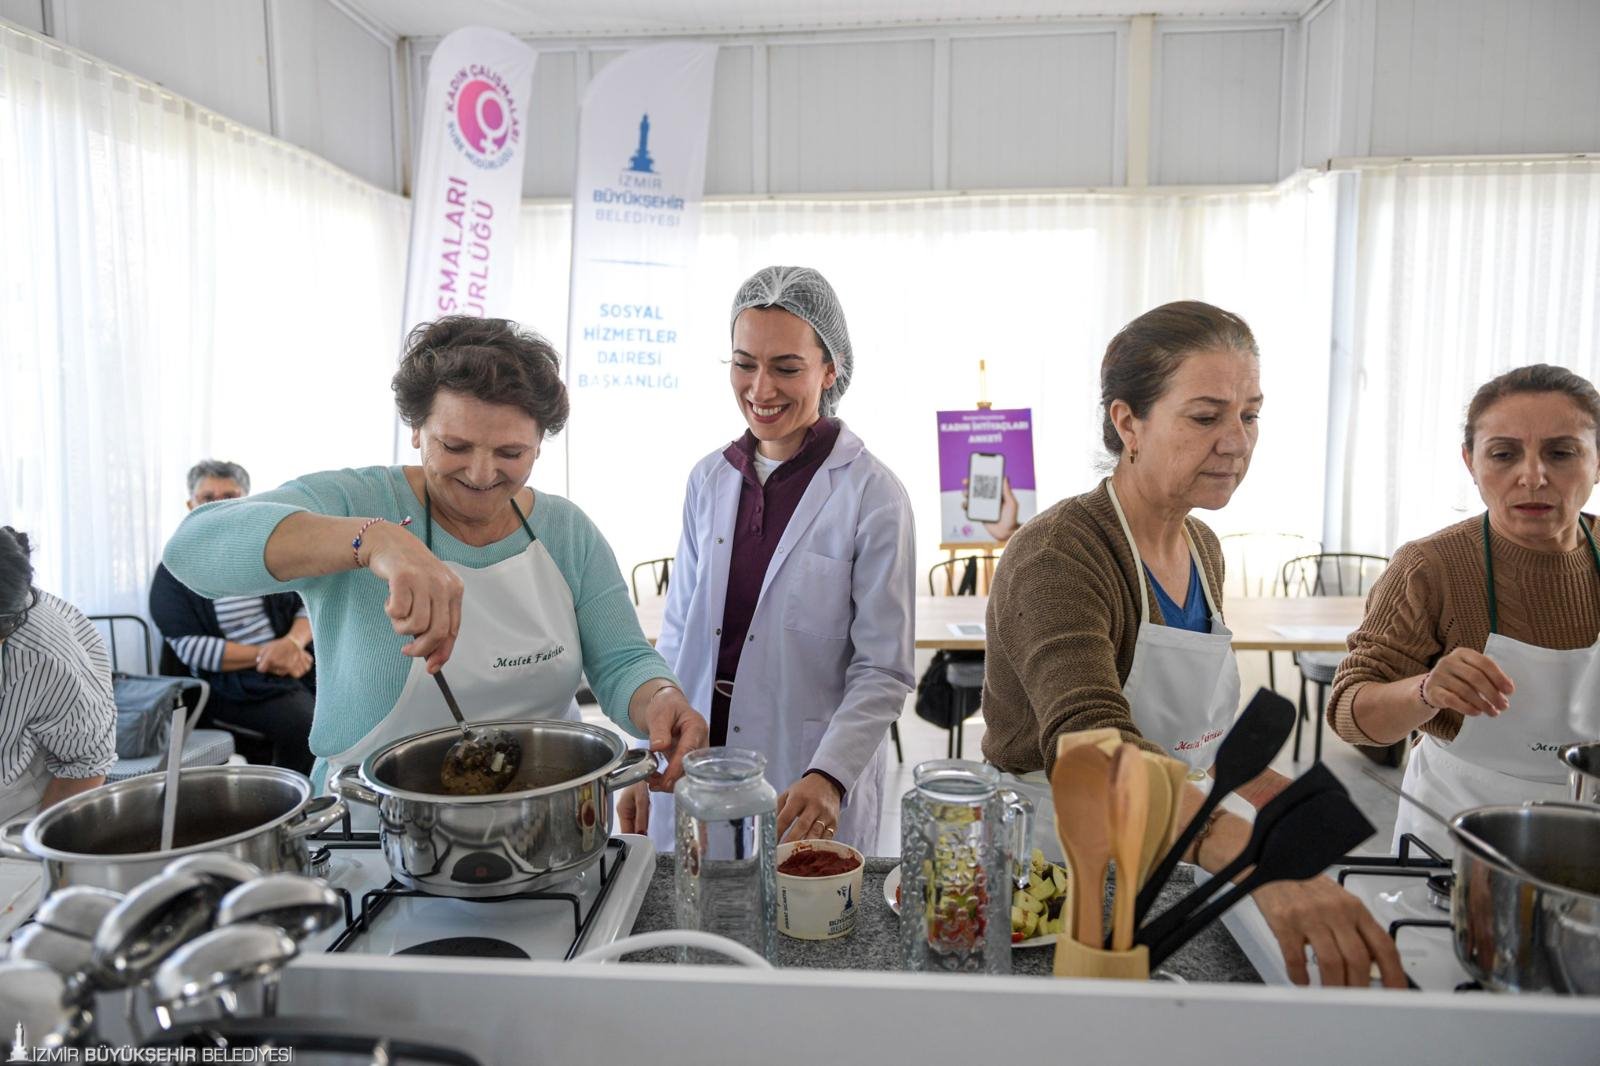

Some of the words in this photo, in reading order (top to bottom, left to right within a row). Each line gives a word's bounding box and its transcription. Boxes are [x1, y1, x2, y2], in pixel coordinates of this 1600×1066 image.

[592, 187, 686, 211] BÜYÜKŞEHİR
[594, 208, 681, 227] BELEDİYESİ
[438, 176, 468, 316] ŞMALARI
[599, 303, 663, 321] SOSYAL
[583, 324, 677, 343] HİZMETLER
[597, 349, 662, 366] DAİRESİ
[578, 372, 679, 389] BAŞKANLIĞI
[493, 655, 533, 668] Meslek
